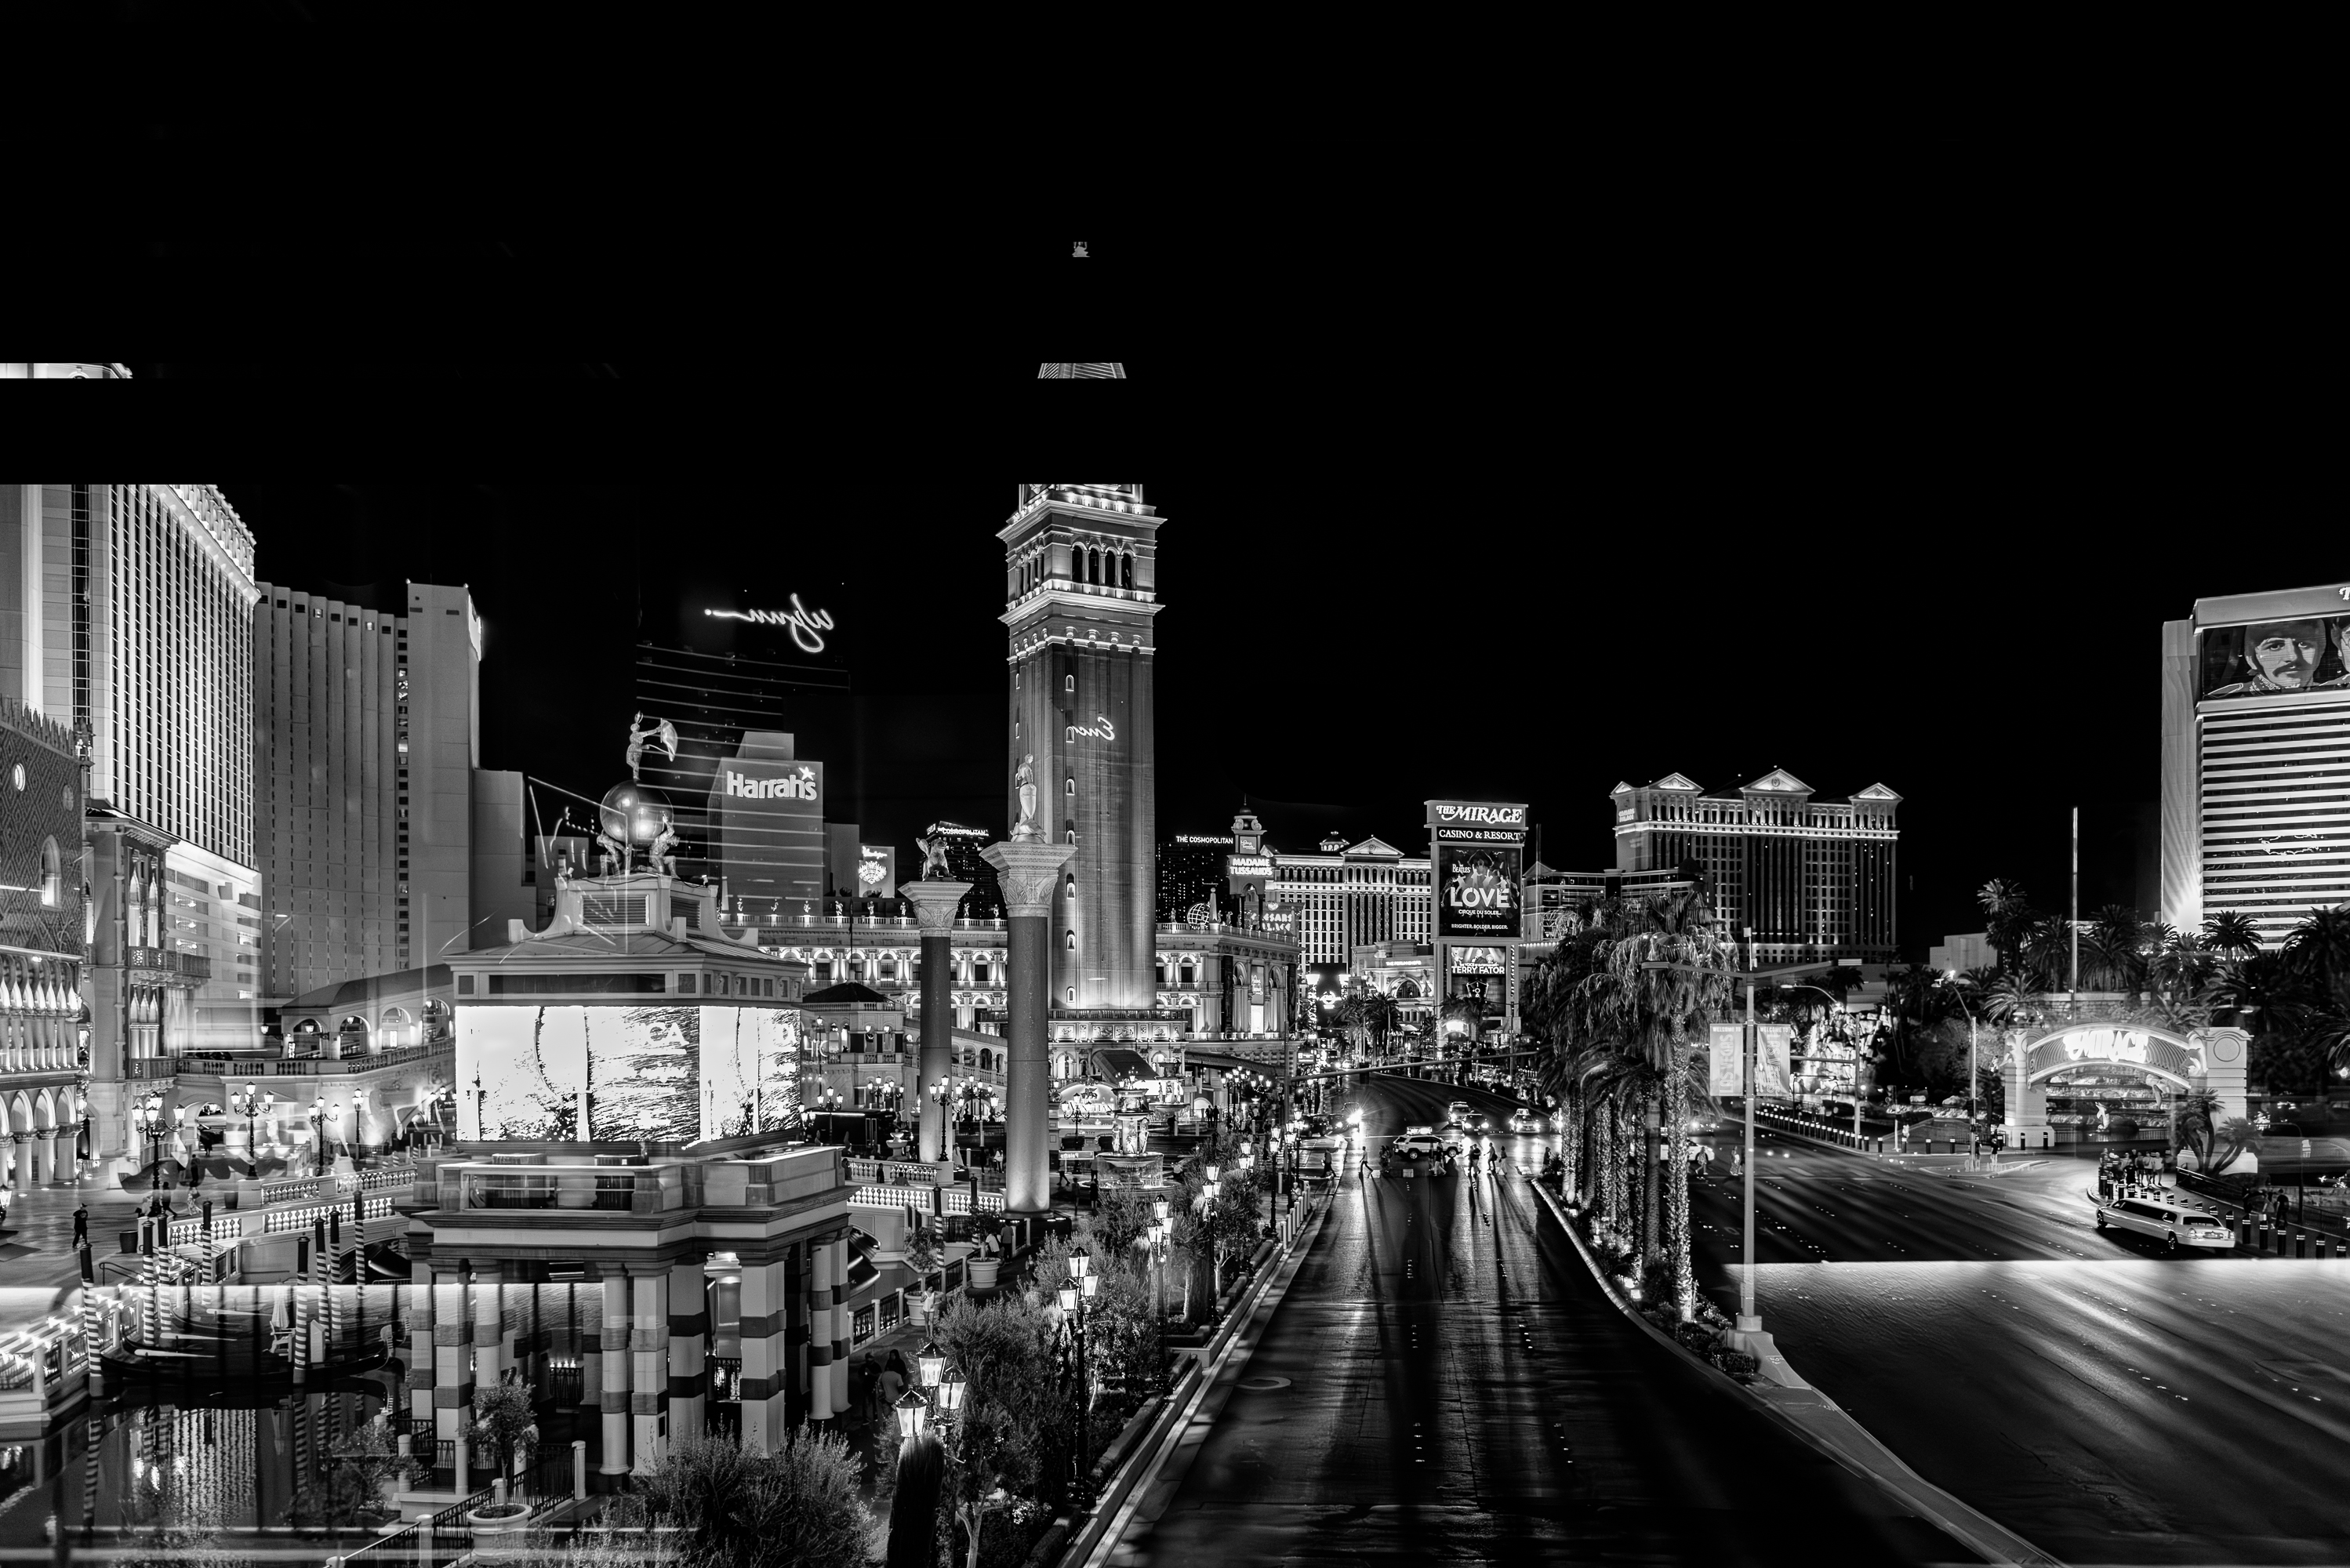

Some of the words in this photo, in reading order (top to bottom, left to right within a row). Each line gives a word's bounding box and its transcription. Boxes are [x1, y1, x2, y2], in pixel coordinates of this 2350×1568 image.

[1436, 805, 1456, 815] THE
[1441, 806, 1522, 824] MIRAGE
[1439, 829, 1473, 839] CASINO
[1484, 831, 1520, 840] RESORT
[1451, 887, 1509, 908] LOVE
[1719, 1034, 1734, 1069] VEGAS
[1719, 1072, 1734, 1094] LAS
